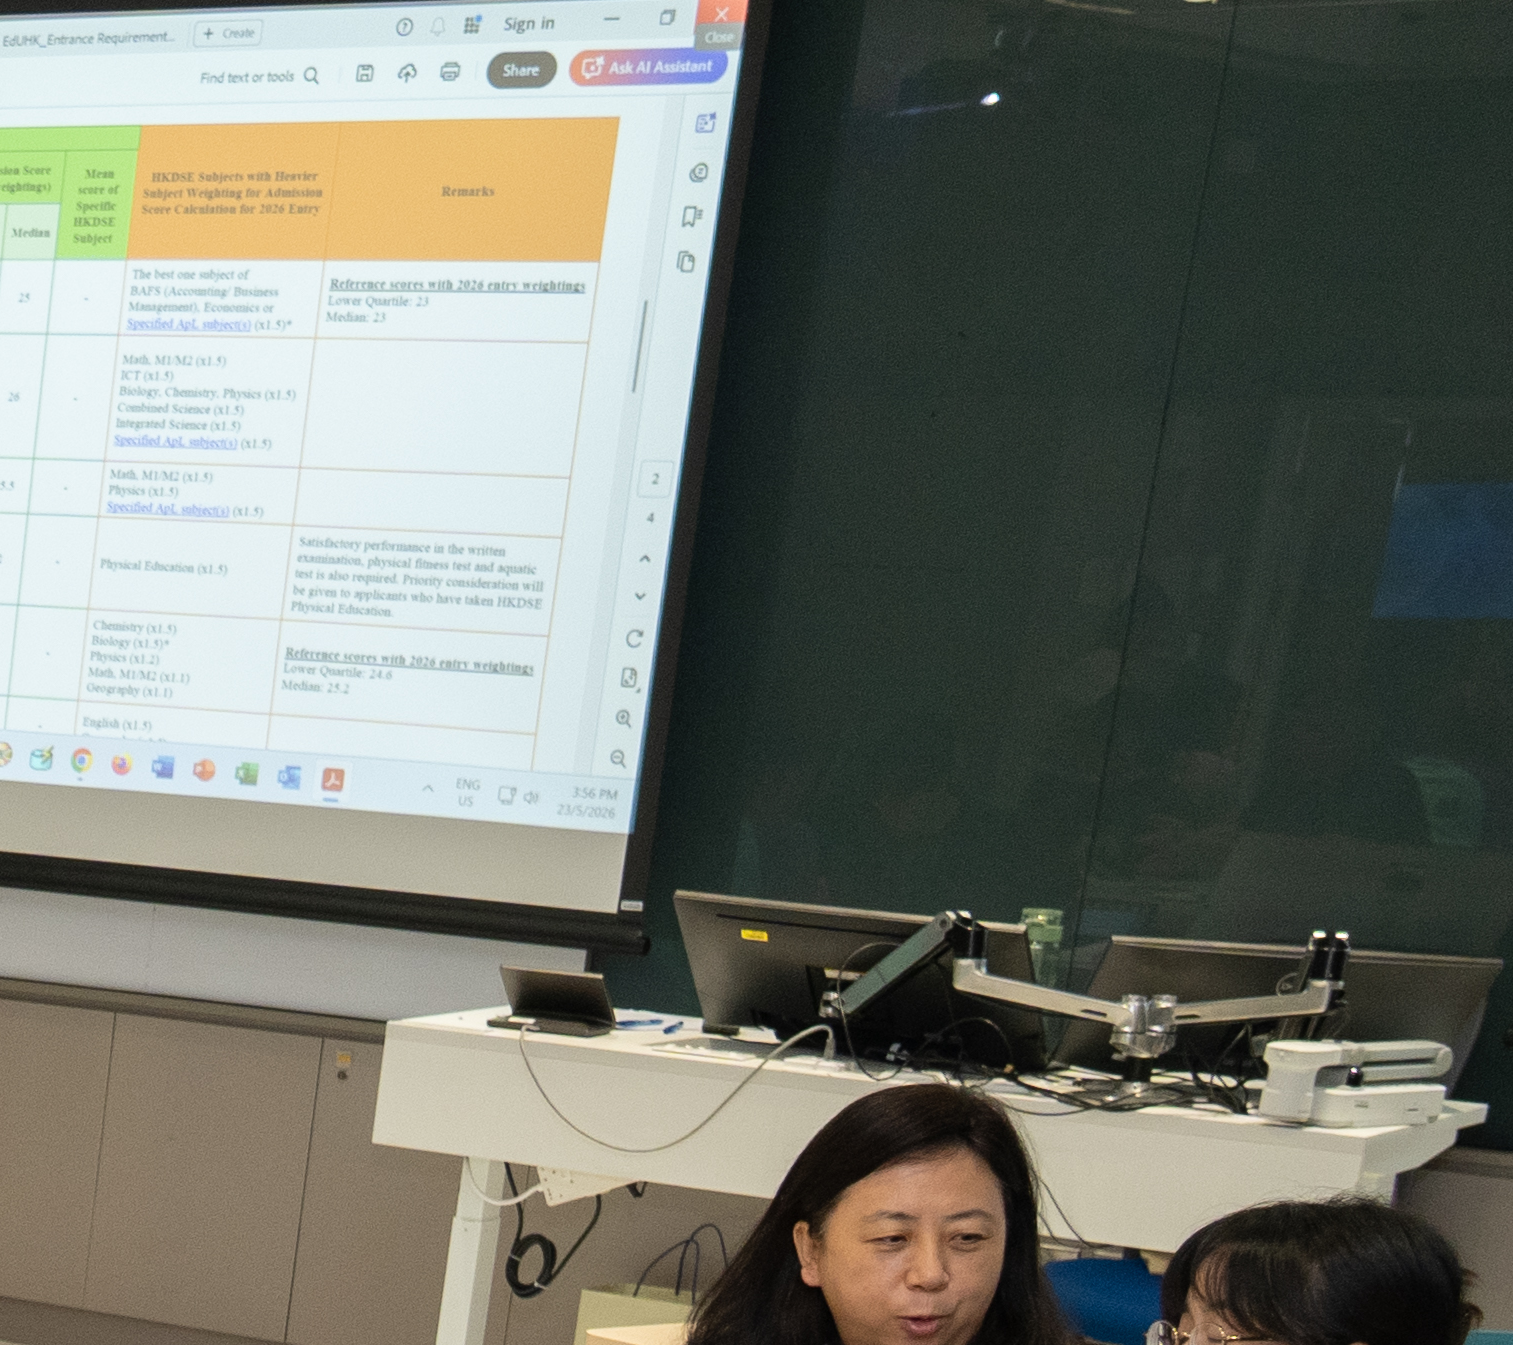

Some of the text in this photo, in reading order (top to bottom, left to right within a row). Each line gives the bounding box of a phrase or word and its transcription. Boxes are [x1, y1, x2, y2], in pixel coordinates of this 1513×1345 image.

[503, 16, 556, 34] Sign in
[502, 63, 541, 77] Share
[607, 59, 713, 75] Ask AI Assistant
[199, 69, 296, 84] Find text or tools
[440, 185, 496, 197] Remarks
[651, 472, 661, 485] 2
[645, 512, 656, 523] 4
[454, 777, 482, 791] ENG
[456, 794, 475, 808] US
